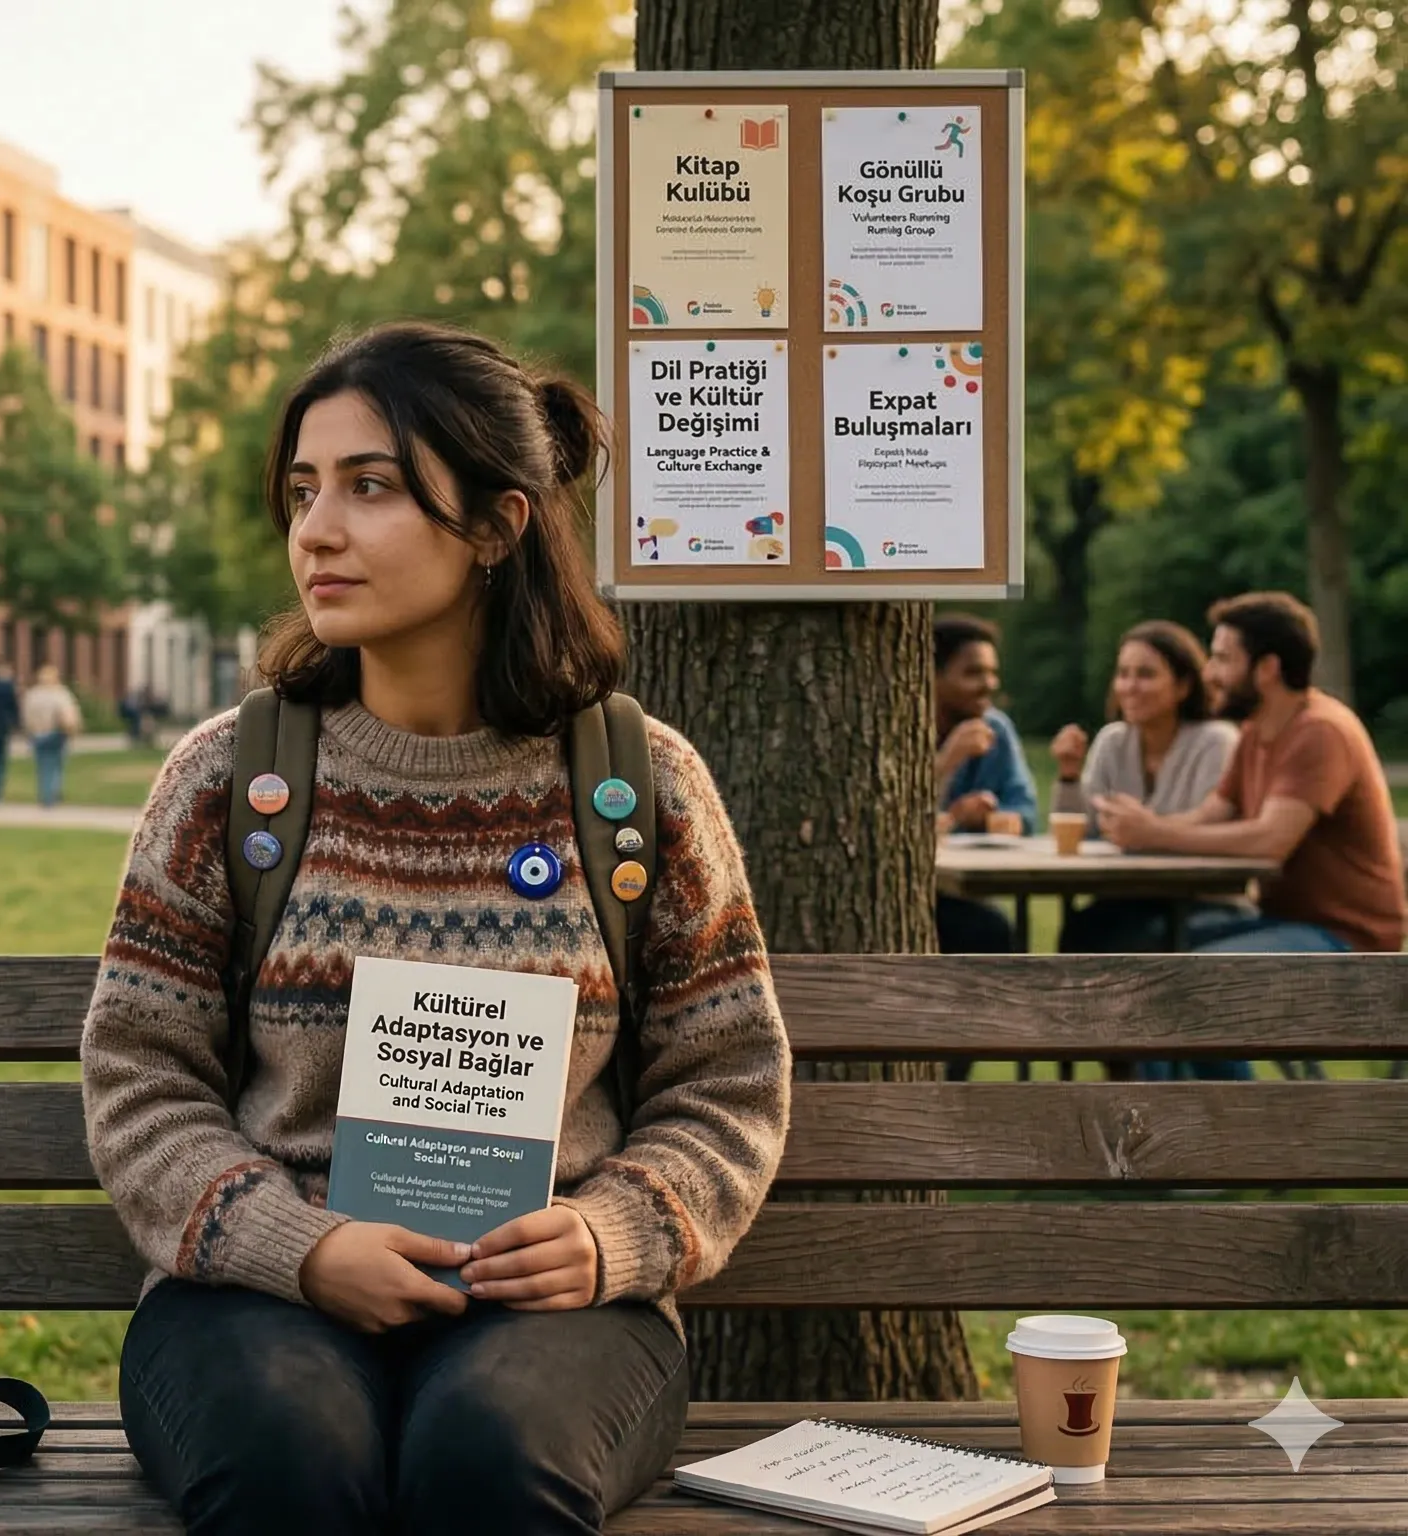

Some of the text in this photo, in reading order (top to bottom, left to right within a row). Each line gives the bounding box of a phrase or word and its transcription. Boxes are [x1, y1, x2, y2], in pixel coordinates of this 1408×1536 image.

[677, 156, 739, 180] Kitap
[860, 160, 942, 178] Gönüllü
[667, 182, 750, 202] Kulübü
[839, 185, 964, 208] Koşu Grubu
[905, 225, 935, 236] Group
[652, 360, 766, 387] Dil Pratiği
[655, 386, 763, 406] ve Kültür
[870, 391, 937, 415] Expat
[659, 412, 758, 437] Değişimi
[835, 416, 971, 441] Buluşmaları
[647, 446, 770, 460] Language Practice &
[657, 460, 762, 474] Culture Exchange
[414, 992, 506, 1019] Kültürel
[371, 1014, 543, 1051] Adaptasyon ve
[377, 1042, 534, 1078] Sosyal Bağlar
[380, 1074, 524, 1102] Cultural Adaptation
[393, 1095, 506, 1117] and Social Ties
[470, 1146, 489, 1156] and
